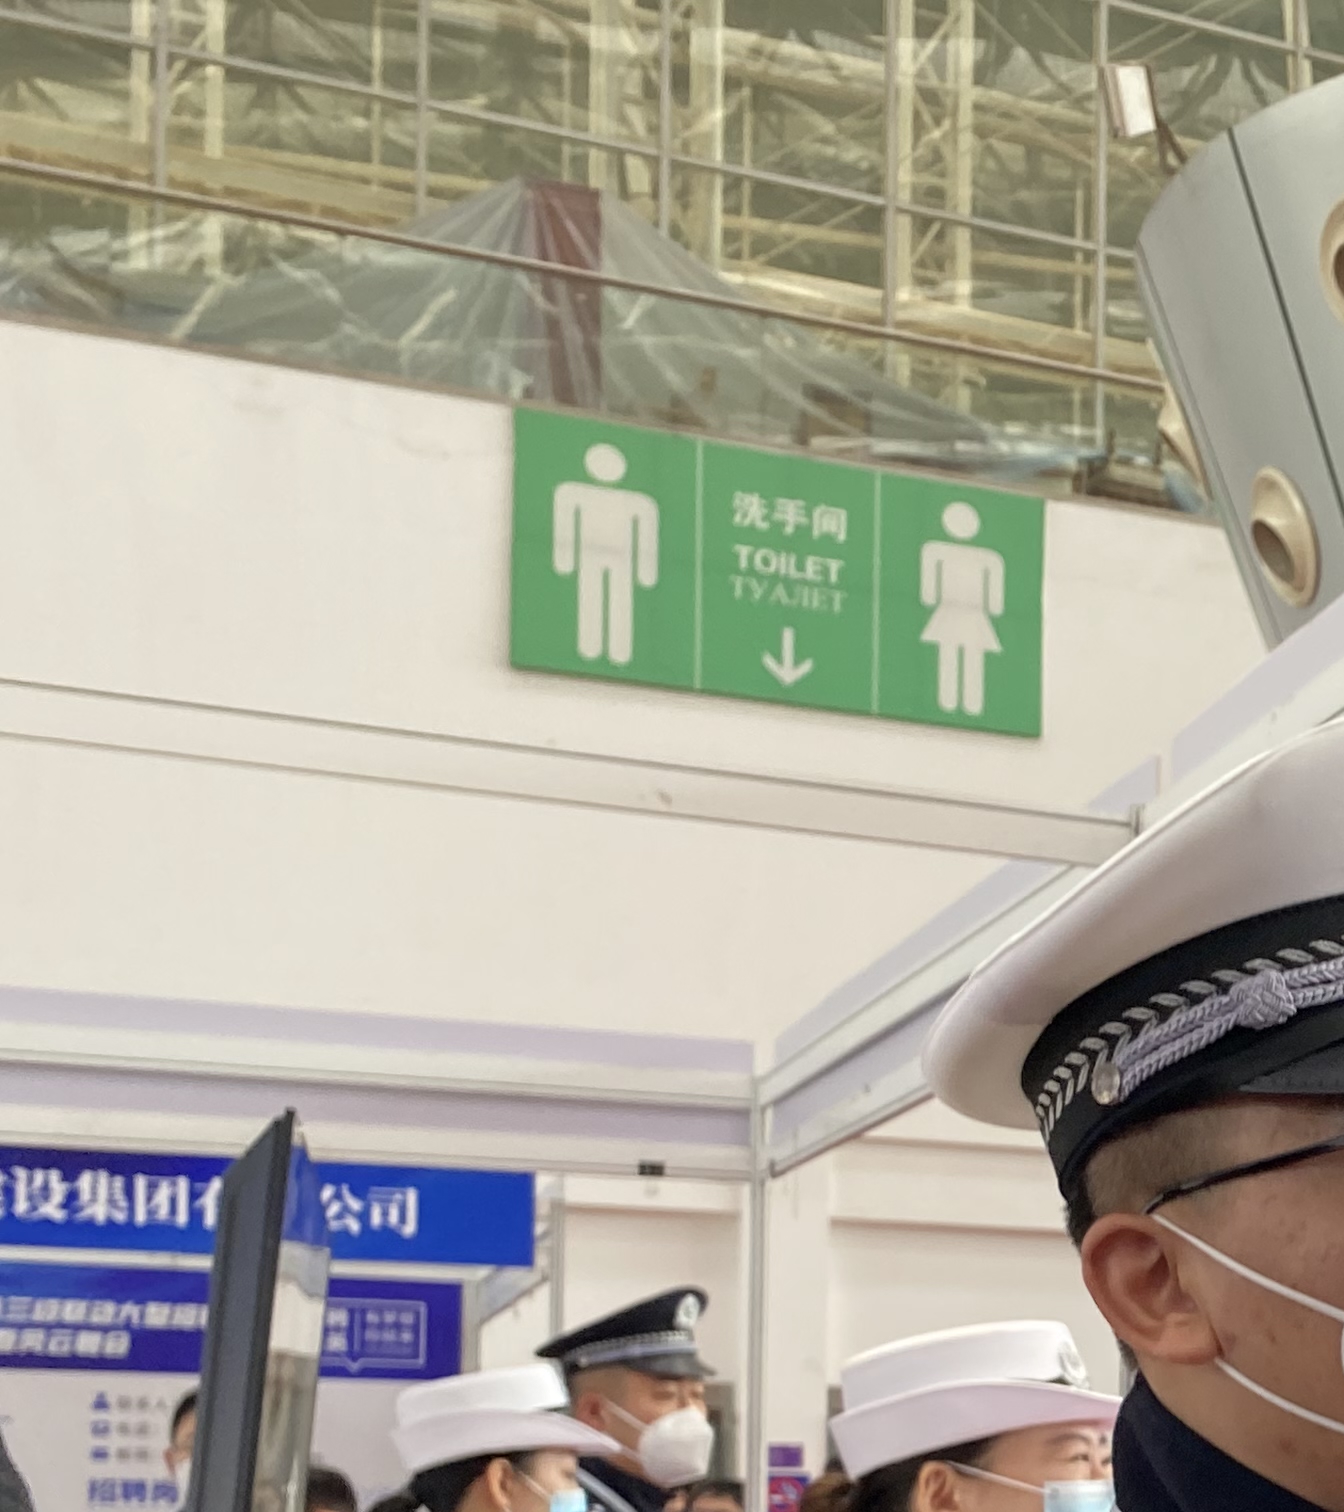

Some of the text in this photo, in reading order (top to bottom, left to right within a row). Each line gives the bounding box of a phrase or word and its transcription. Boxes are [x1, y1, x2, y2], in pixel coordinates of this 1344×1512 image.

[732, 491, 848, 543] 洗手间
[732, 544, 845, 584] TOILET
